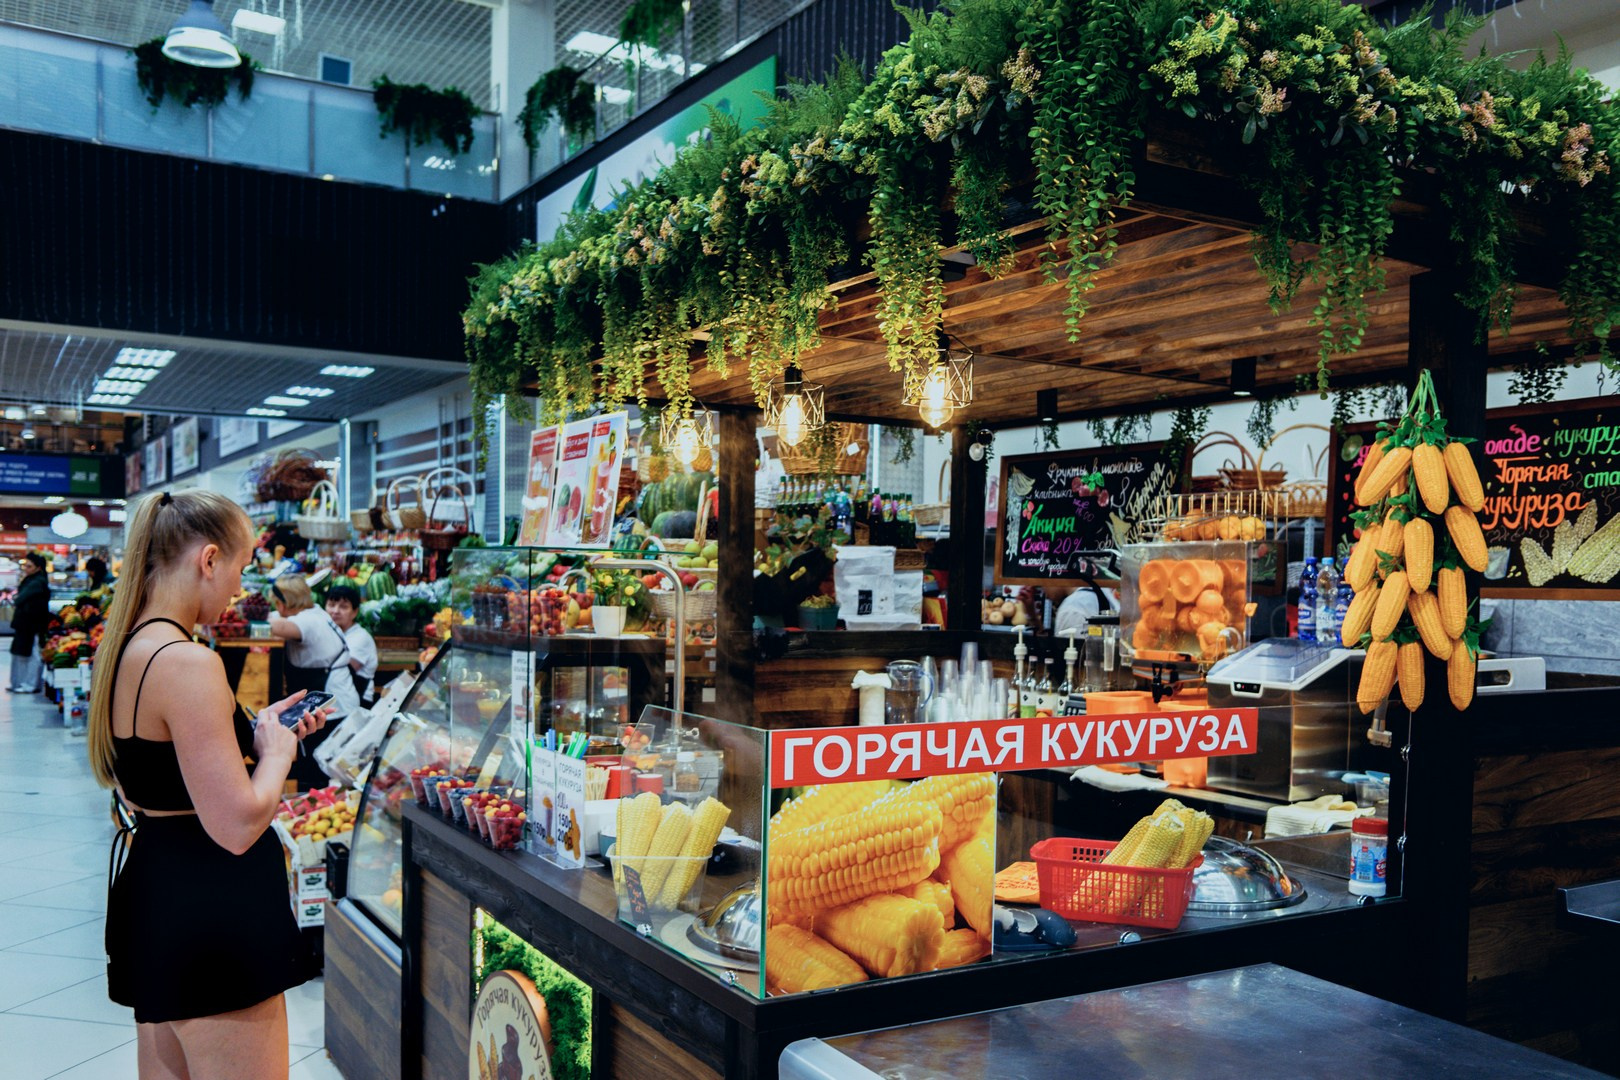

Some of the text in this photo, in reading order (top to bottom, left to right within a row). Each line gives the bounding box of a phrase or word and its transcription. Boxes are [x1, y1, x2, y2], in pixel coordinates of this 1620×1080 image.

[1484, 424, 1542, 455] оладе
[1554, 425, 1620, 458] кукуру
[1047, 462, 1088, 486] Фрукты
[1101, 456, 1145, 474] шоколаде
[1493, 455, 1572, 497] Горячая
[1022, 504, 1077, 541] Акция
[1052, 536, 1083, 554] 20%
[784, 714, 1248, 781] ГОРЯЧАЯ КУКУРУЗА
[559, 762, 582, 778] ГОРЯЧАЯ
[559, 777, 582, 792] КУКУРУЗА
[476, 987, 509, 1029] Горячая
